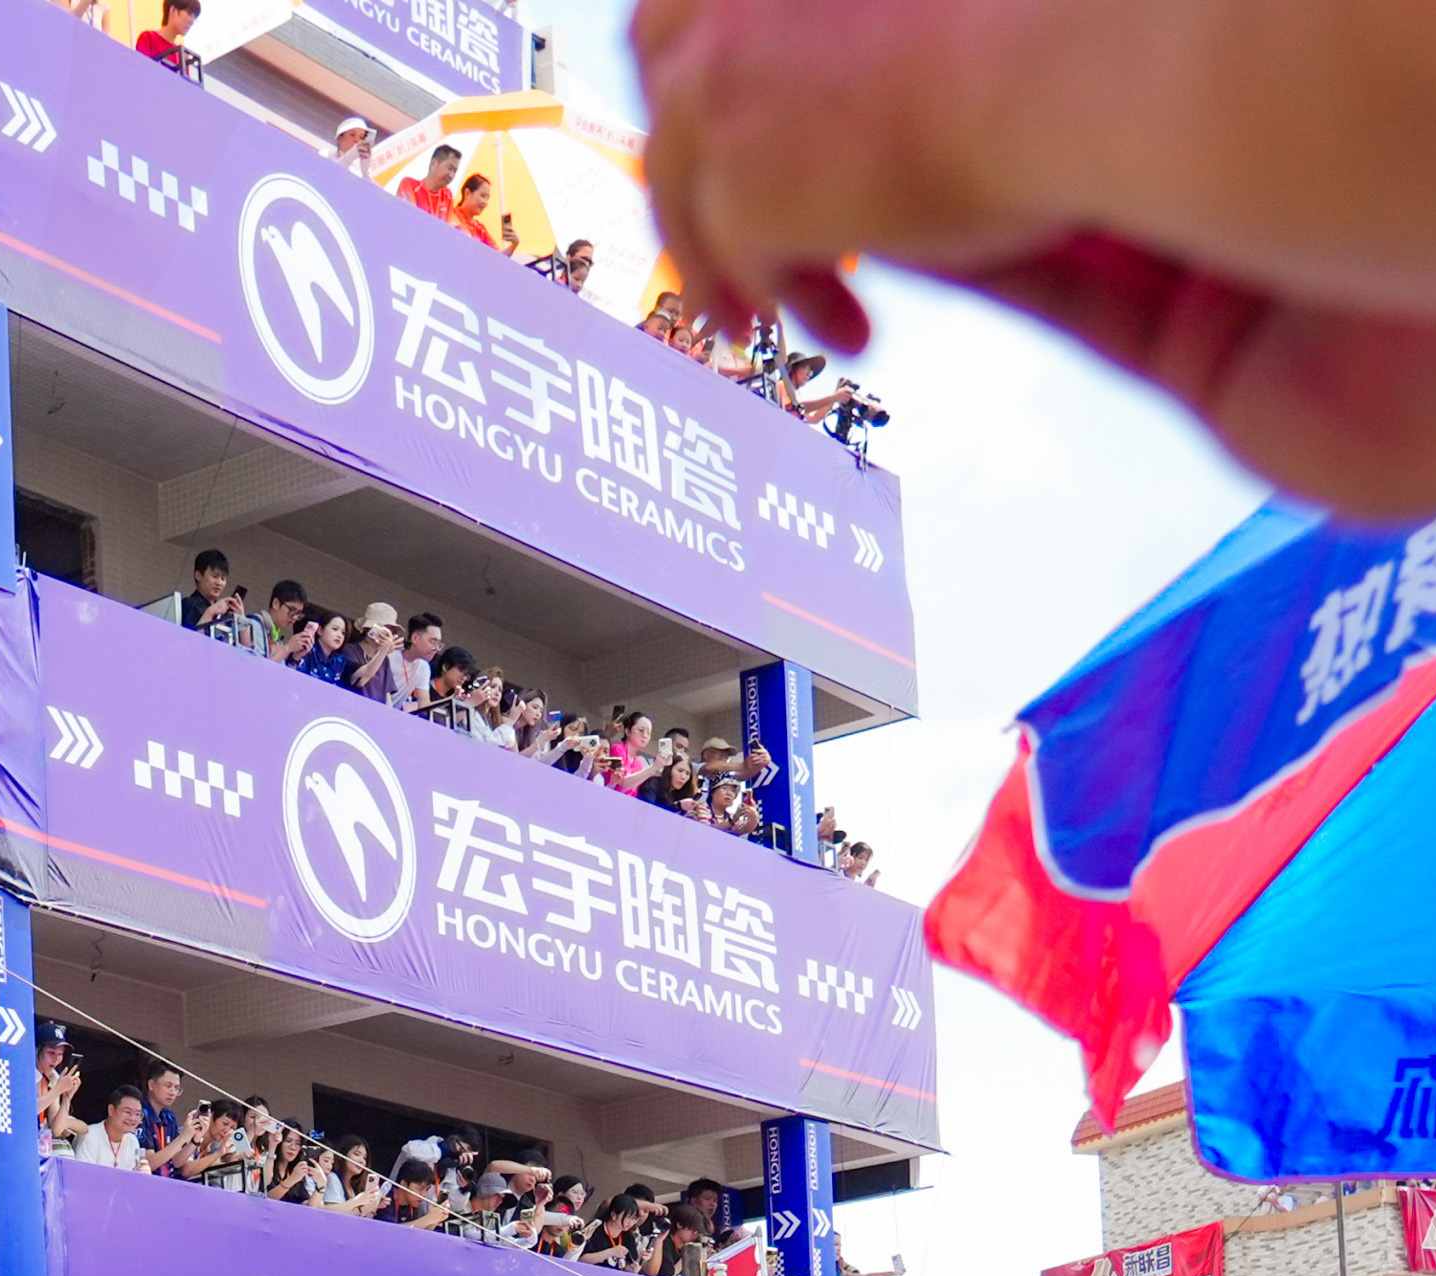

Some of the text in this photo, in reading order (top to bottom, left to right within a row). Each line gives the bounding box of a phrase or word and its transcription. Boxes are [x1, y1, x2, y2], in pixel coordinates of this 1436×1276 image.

[388, 264, 742, 532] 宏宇陶瓷
[393, 375, 746, 573] HONGYU CERAMICS
[430, 790, 780, 995] 宏宇陶瓷
[434, 902, 783, 1036] HONGYU CERAMICS
